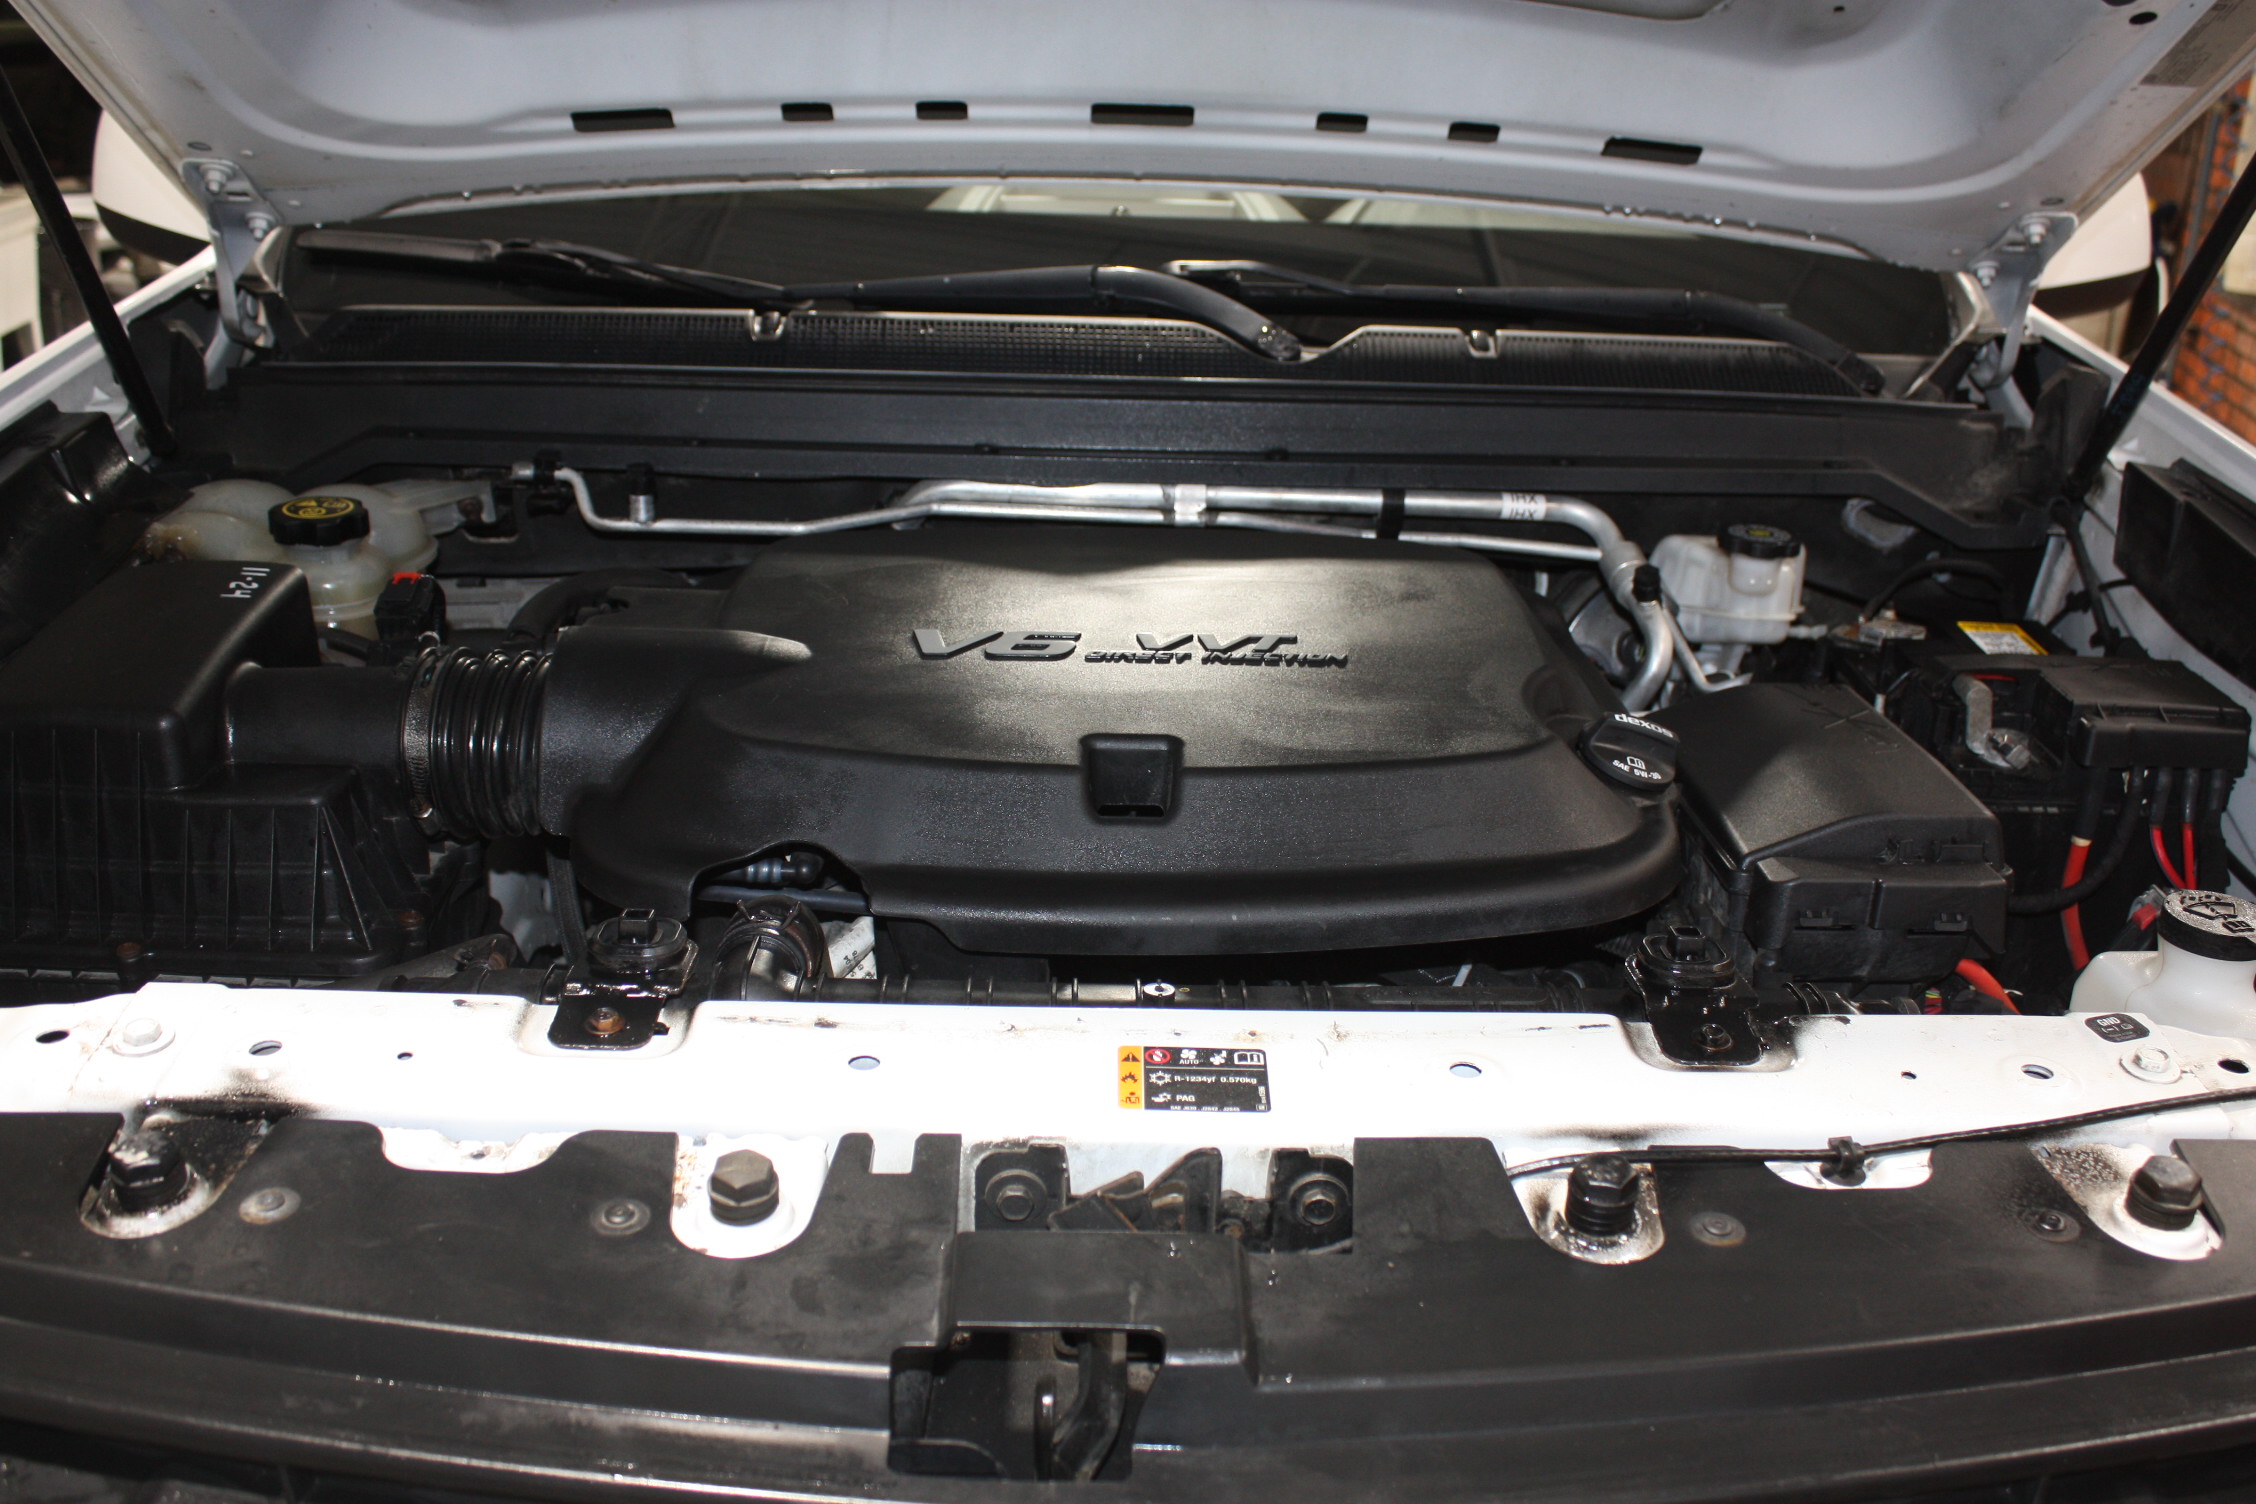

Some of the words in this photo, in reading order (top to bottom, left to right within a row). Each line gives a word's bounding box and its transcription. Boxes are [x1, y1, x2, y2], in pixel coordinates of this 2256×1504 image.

[912, 629, 1082, 660] V6
[1136, 633, 1298, 652] VVT
[1085, 651, 1193, 663] DIRECT
[1201, 651, 1348, 668] INJECTION
[1614, 714, 1674, 738] dexos
[1612, 759, 1630, 773] SAE
[2097, 1016, 2120, 1026] GND
